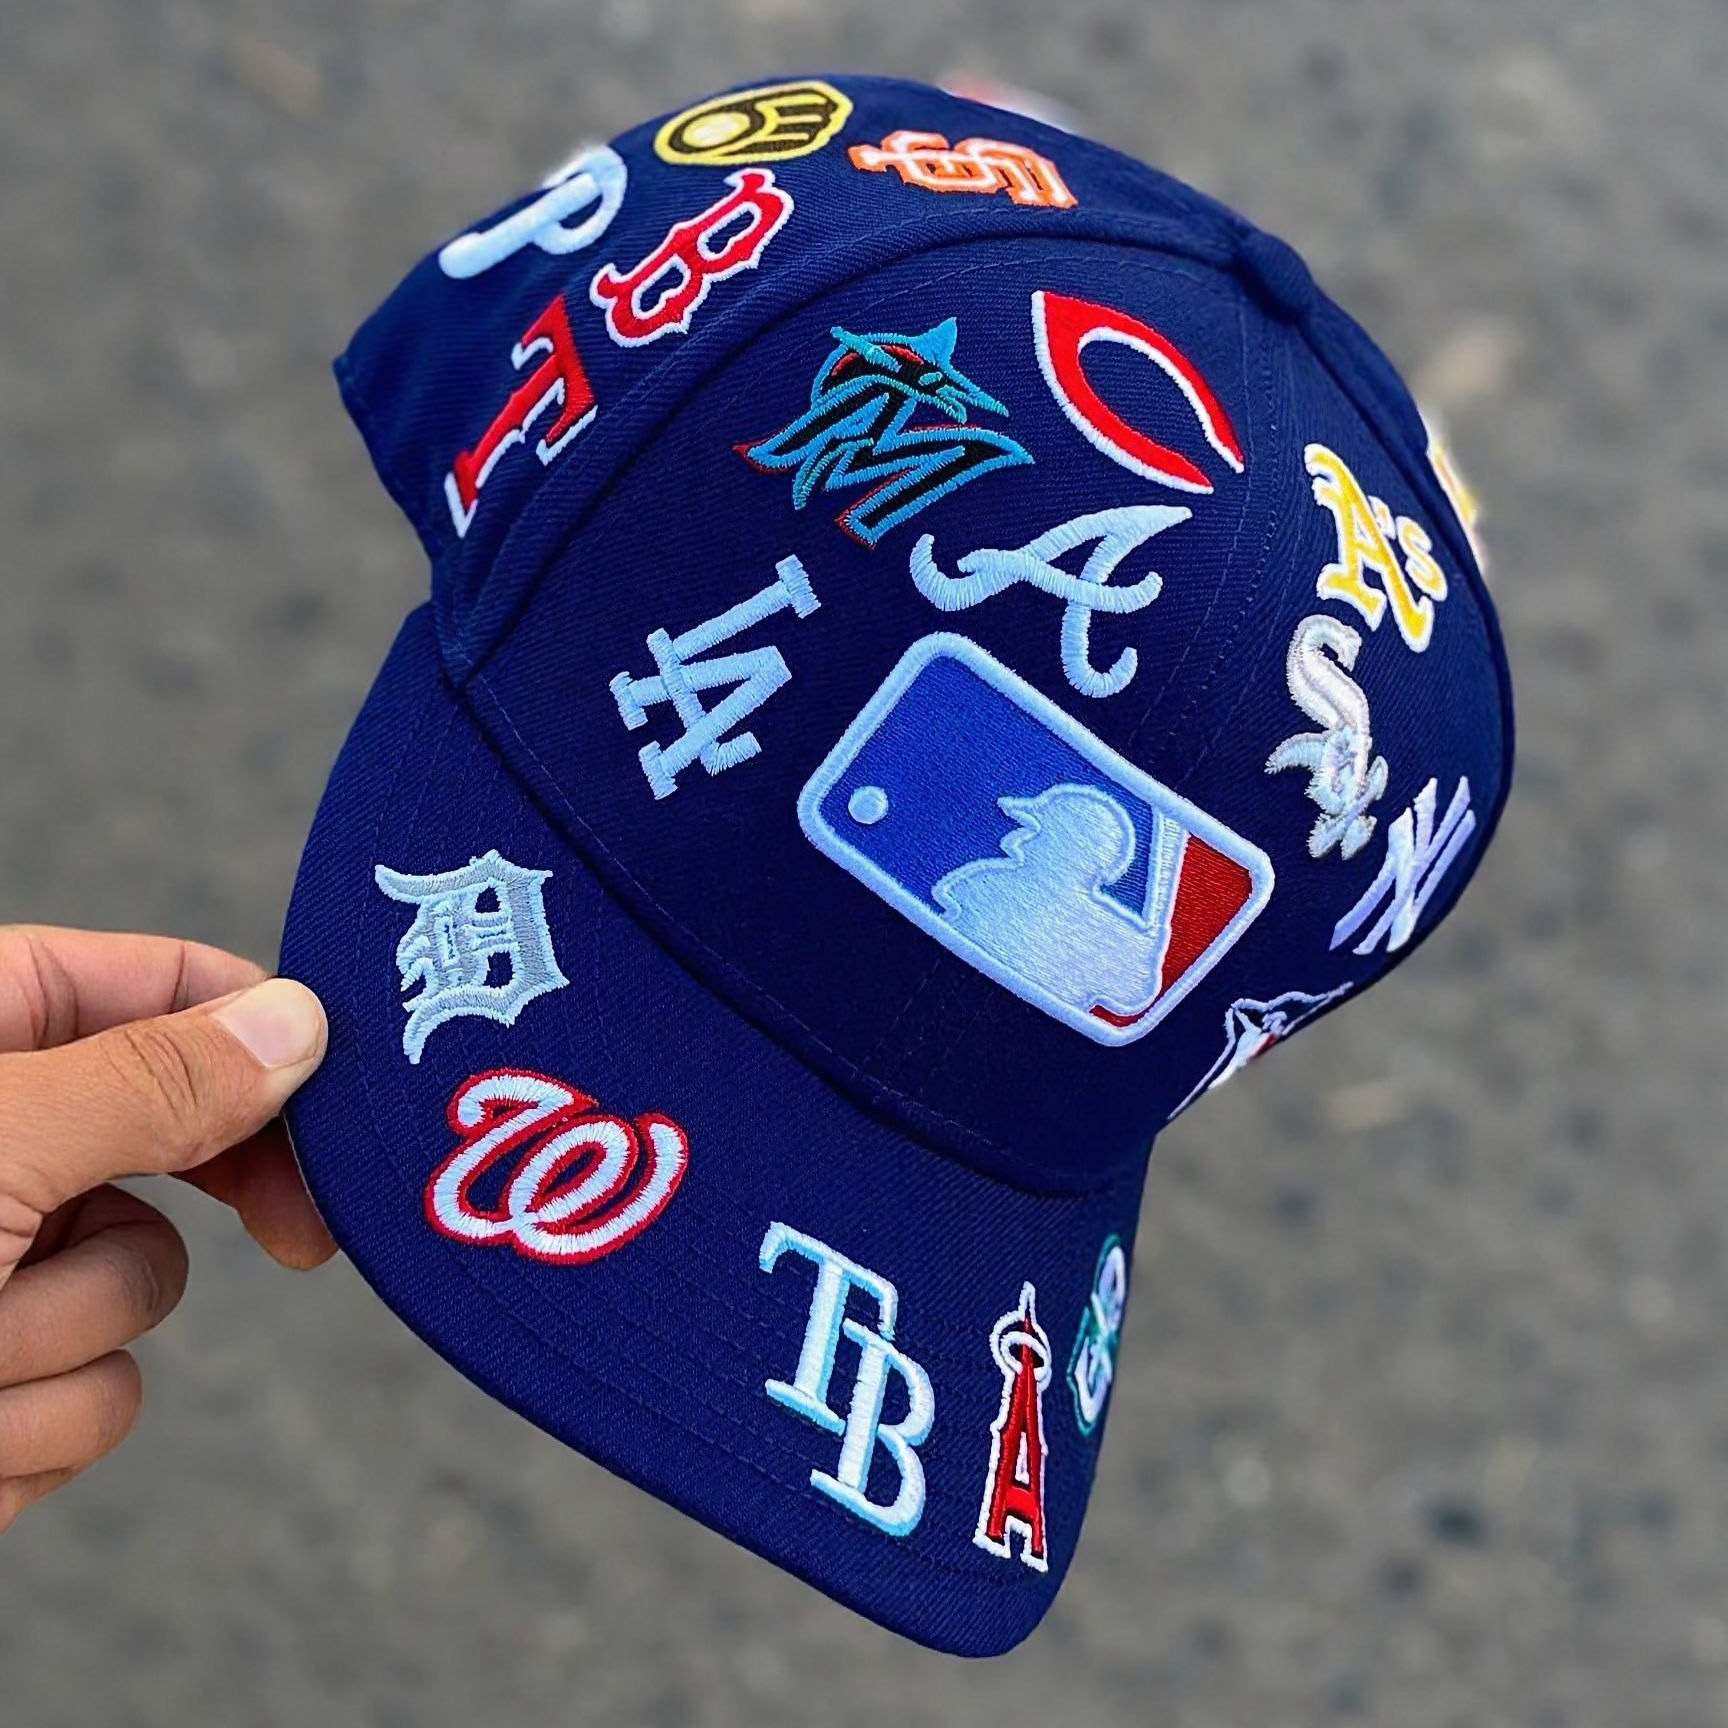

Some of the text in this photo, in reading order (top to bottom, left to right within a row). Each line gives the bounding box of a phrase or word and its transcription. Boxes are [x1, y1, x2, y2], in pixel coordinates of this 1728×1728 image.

[439, 145, 628, 279] P
[590, 168, 794, 348] B
[444, 293, 598, 539] T
[733, 373, 1036, 549] M
[1031, 290, 1244, 494] C
[910, 505, 1193, 698] A
[1304, 443, 1448, 653] A's
[609, 554, 821, 800] LA
[374, 848, 570, 1065] D
[424, 1068, 690, 1266] W
[759, 1220, 937, 1538] TB
[972, 1281, 1051, 1574] A
